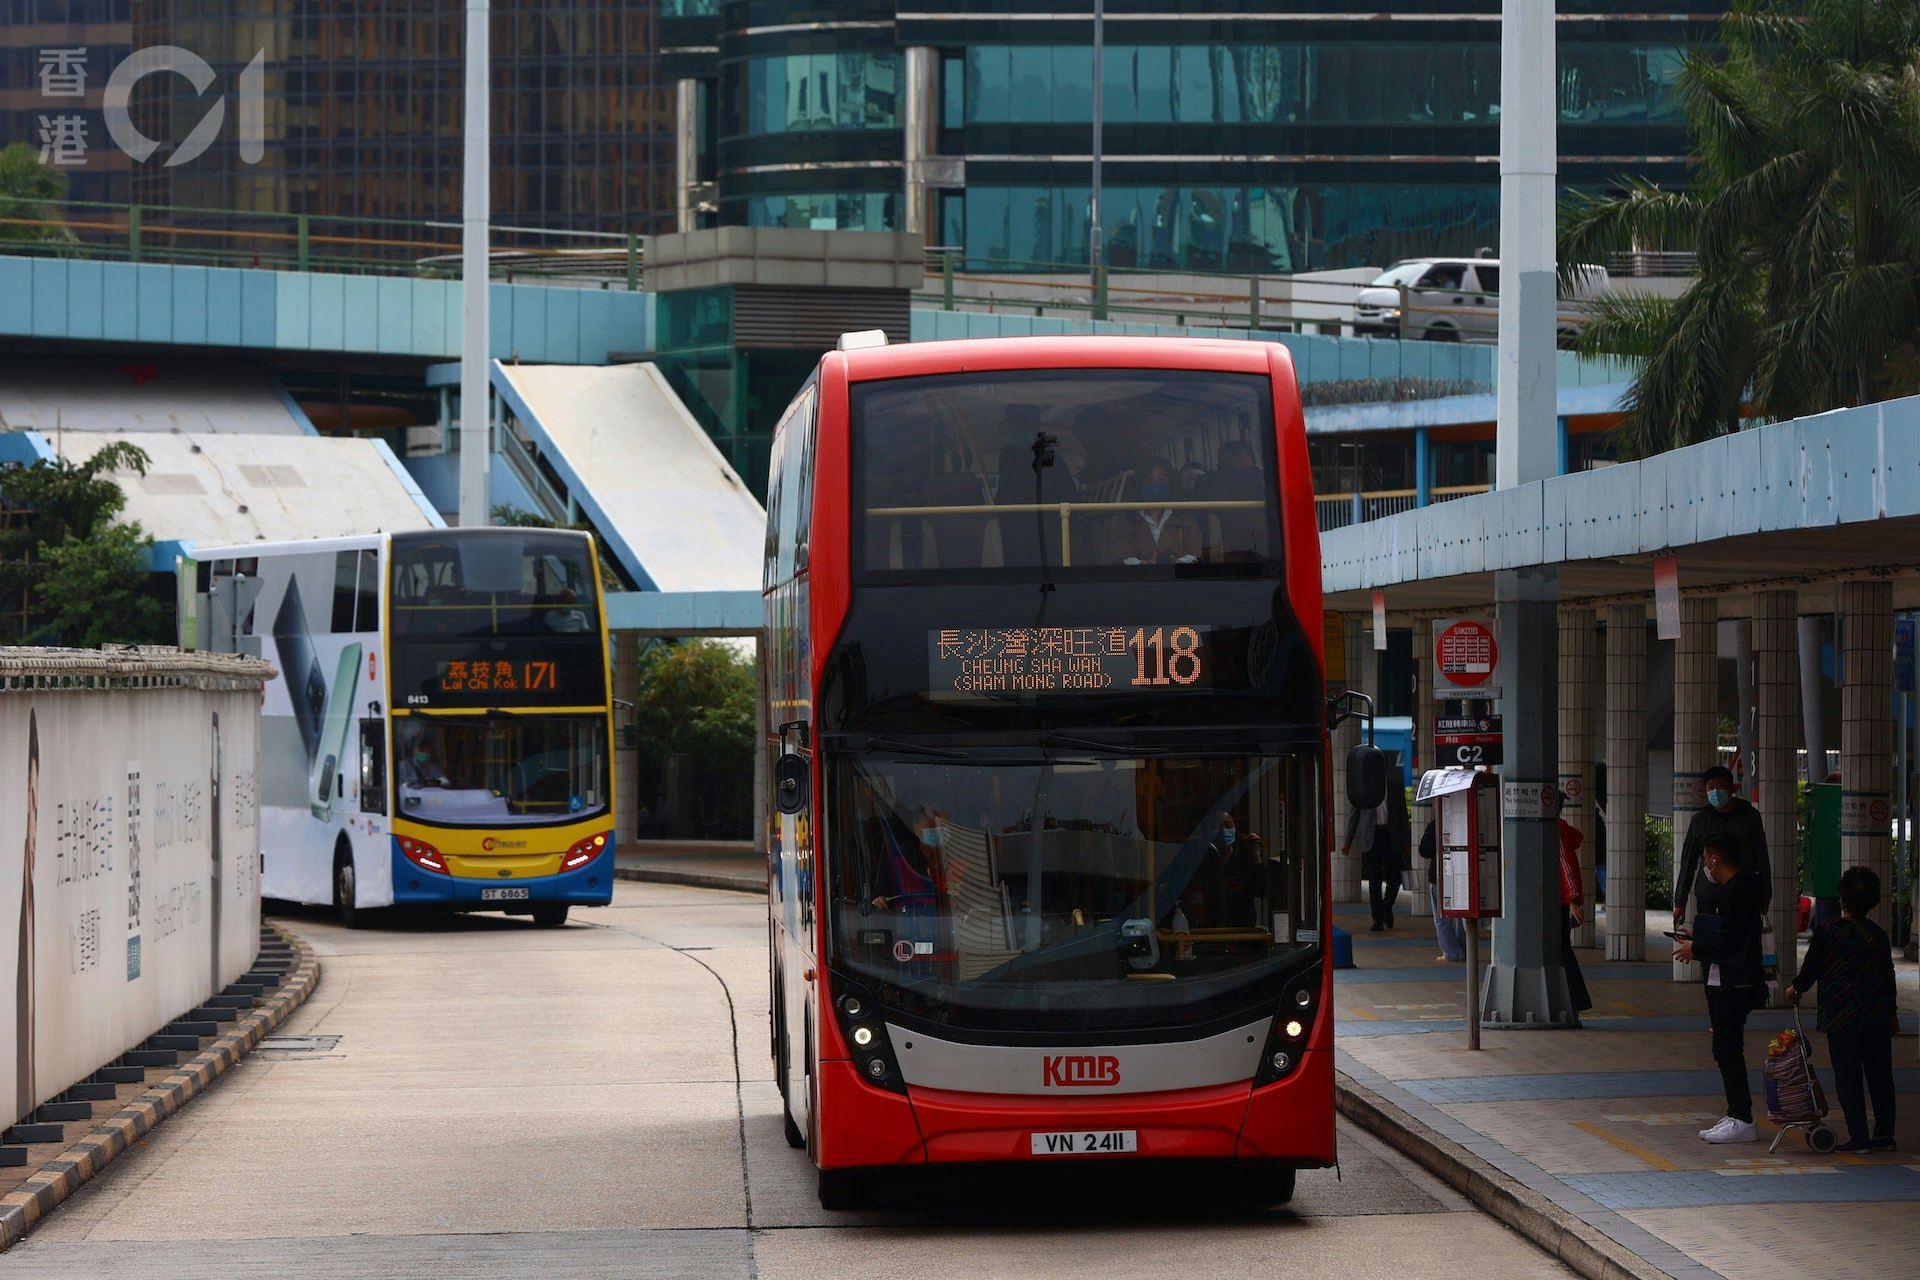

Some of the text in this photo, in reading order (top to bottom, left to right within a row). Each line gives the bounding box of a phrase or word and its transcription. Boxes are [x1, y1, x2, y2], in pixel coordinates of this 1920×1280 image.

[936, 626, 1128, 660] 長沙灣深旺道
[961, 656, 1101, 675] CHEUNG SHA WAN
[1128, 626, 1201, 686] 118
[447, 660, 513, 679] 荔枝角
[523, 661, 556, 689] 171
[441, 678, 518, 690] Lai Chi Kok
[954, 672, 1113, 691] (SHAM MONG ROAD)
[407, 695, 429, 704] 8413
[1445, 736, 1459, 744] 月台
[1456, 745, 1483, 763] C2
[484, 889, 528, 899] ST 6865
[1043, 1055, 1121, 1087] KMB
[1045, 1132, 1124, 1152] VN 2411
